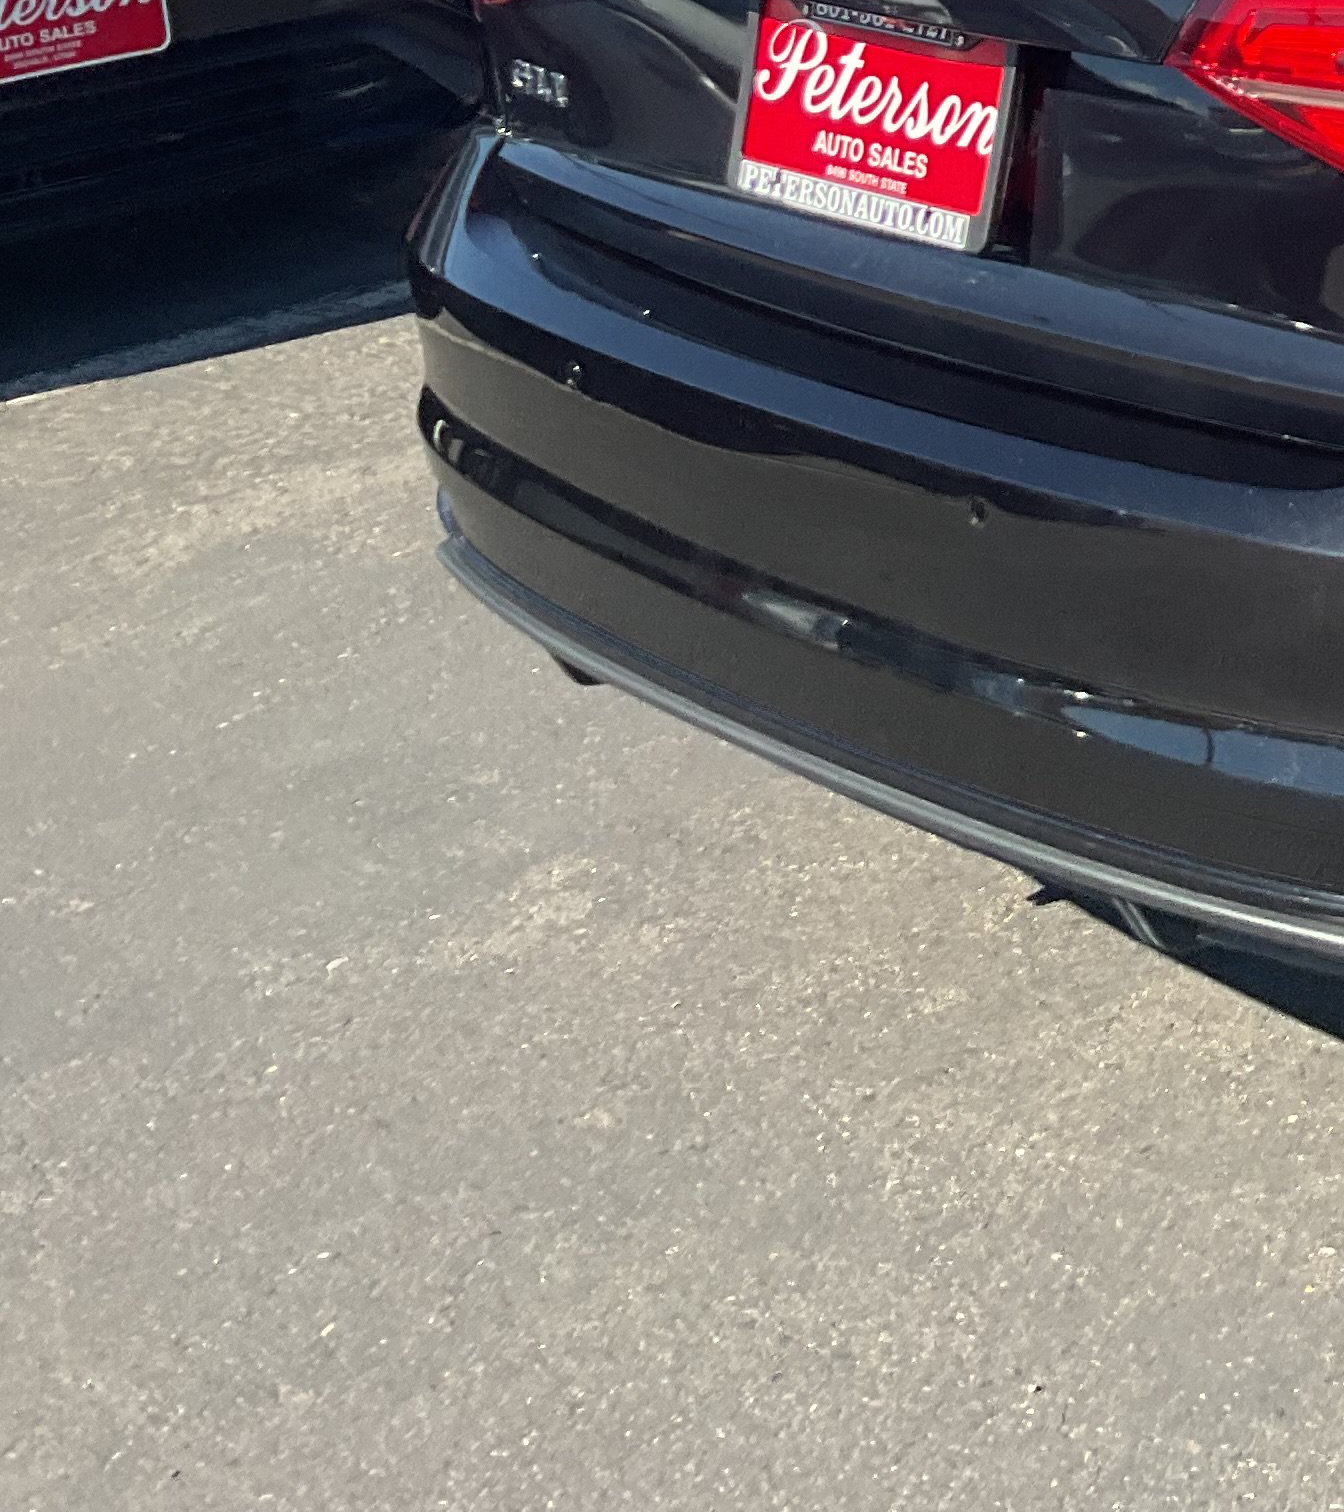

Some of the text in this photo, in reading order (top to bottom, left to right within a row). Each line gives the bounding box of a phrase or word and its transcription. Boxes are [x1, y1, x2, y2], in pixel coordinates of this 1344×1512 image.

[39, 19, 97, 43] SALES
[756, 18, 999, 156] Peterson
[812, 129, 929, 179] AUTO SALES
[742, 163, 966, 244] PETERSONAUTO.COM
[848, 168, 879, 187] SOUTH
[880, 174, 908, 194] STATE
